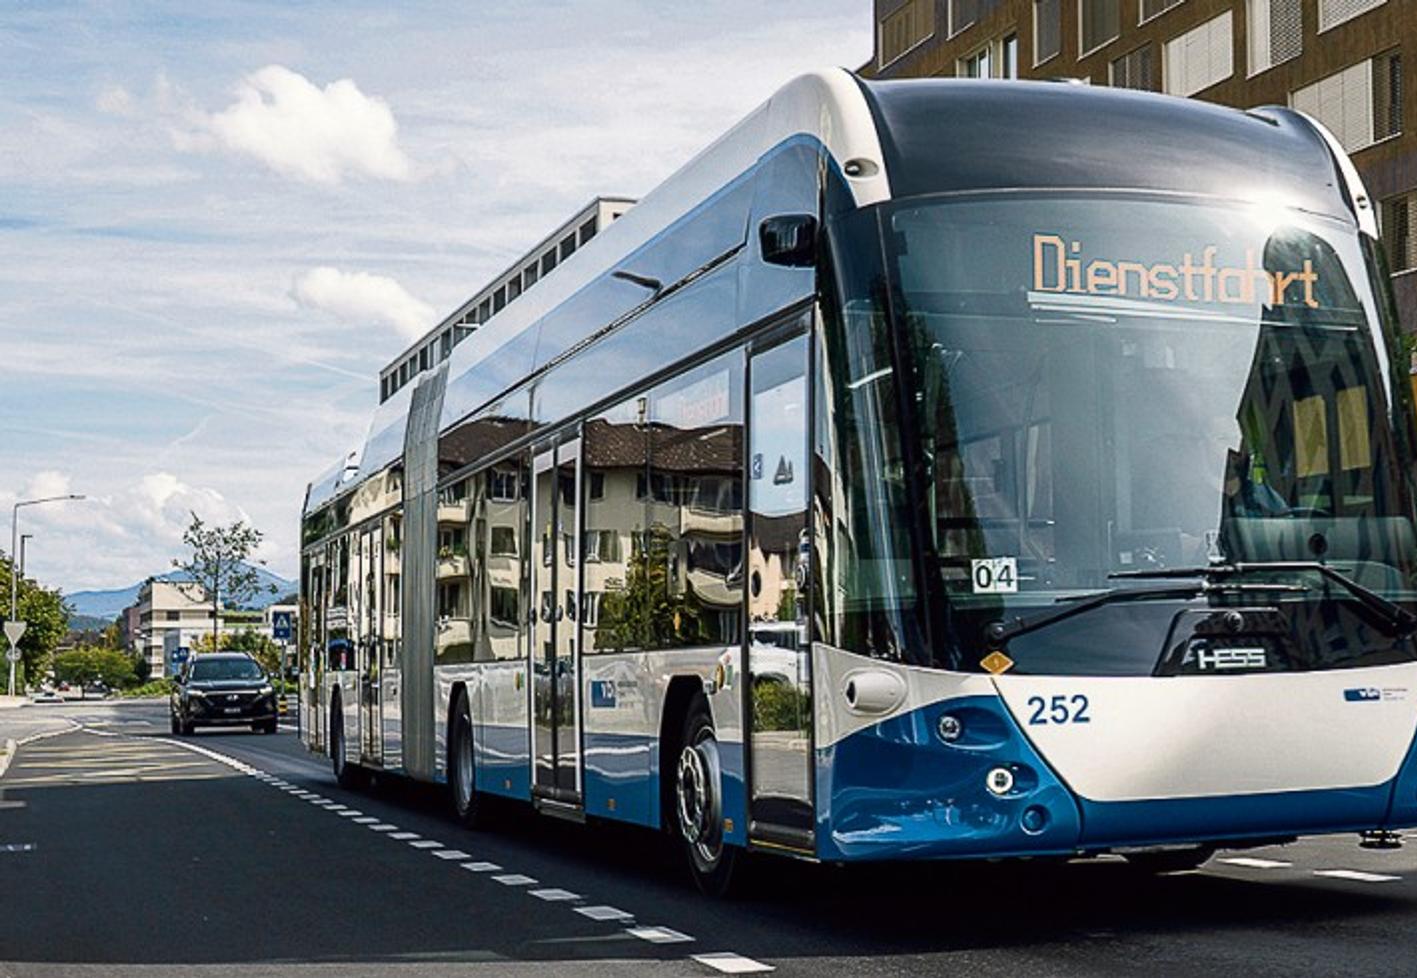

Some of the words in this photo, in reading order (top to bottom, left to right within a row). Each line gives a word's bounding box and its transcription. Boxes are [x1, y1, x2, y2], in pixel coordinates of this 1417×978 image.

[1033, 233, 1319, 309] Dienstfahrt
[975, 564, 1014, 589] 04
[1197, 647, 1267, 670] HESS
[1027, 694, 1091, 726] 252
